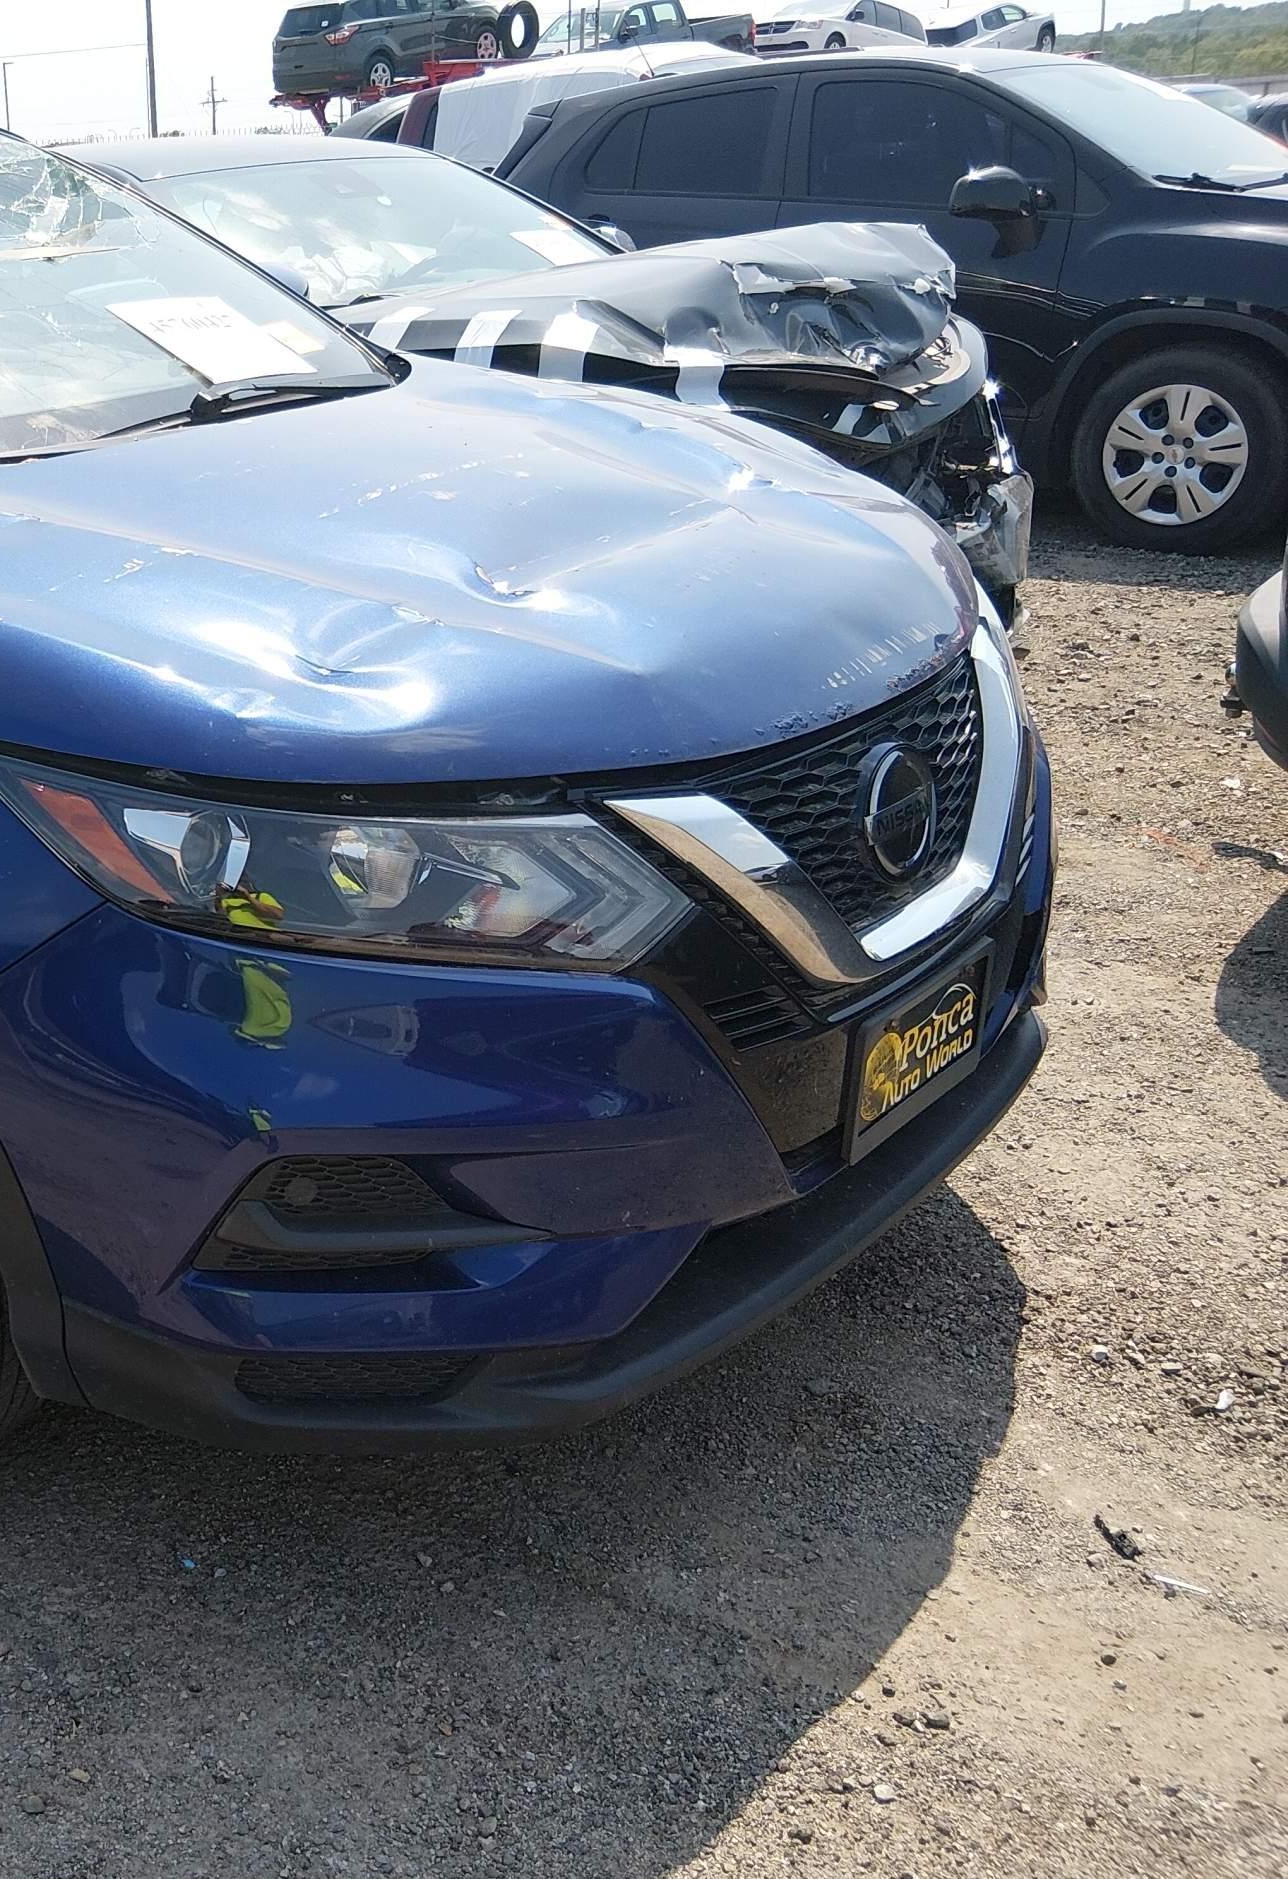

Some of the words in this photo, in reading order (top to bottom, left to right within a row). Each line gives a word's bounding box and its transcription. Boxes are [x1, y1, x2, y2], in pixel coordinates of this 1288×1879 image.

[880, 1067, 921, 1113] AUTO
[926, 1028, 973, 1078] WORLD
[898, 992, 974, 1072] Ponca
